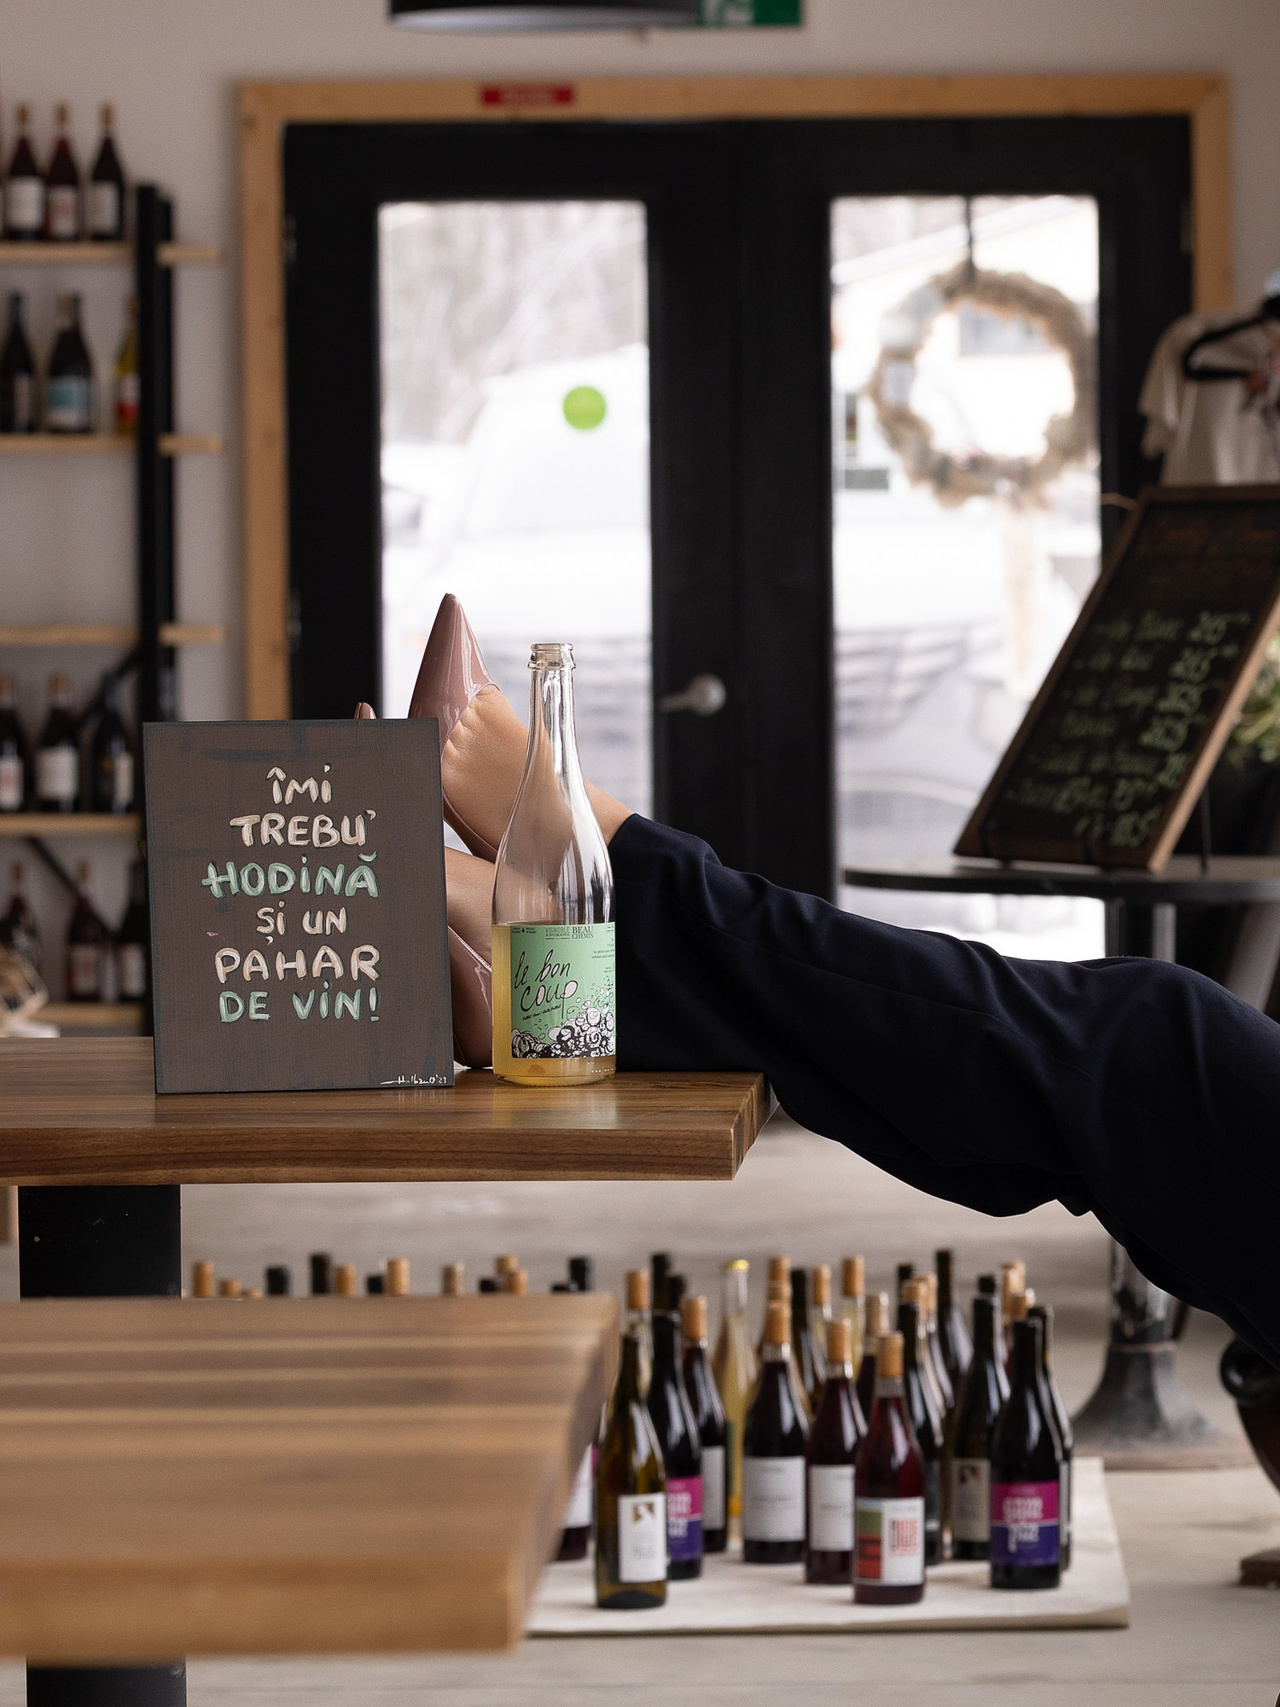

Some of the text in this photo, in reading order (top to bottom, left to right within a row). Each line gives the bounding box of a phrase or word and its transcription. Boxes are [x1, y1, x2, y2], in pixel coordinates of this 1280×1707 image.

[302, 907, 347, 935] UN
[215, 945, 380, 984] PAHAR
[514, 951, 529, 989] le
[535, 949, 571, 982] bon
[219, 991, 271, 1023] DE
